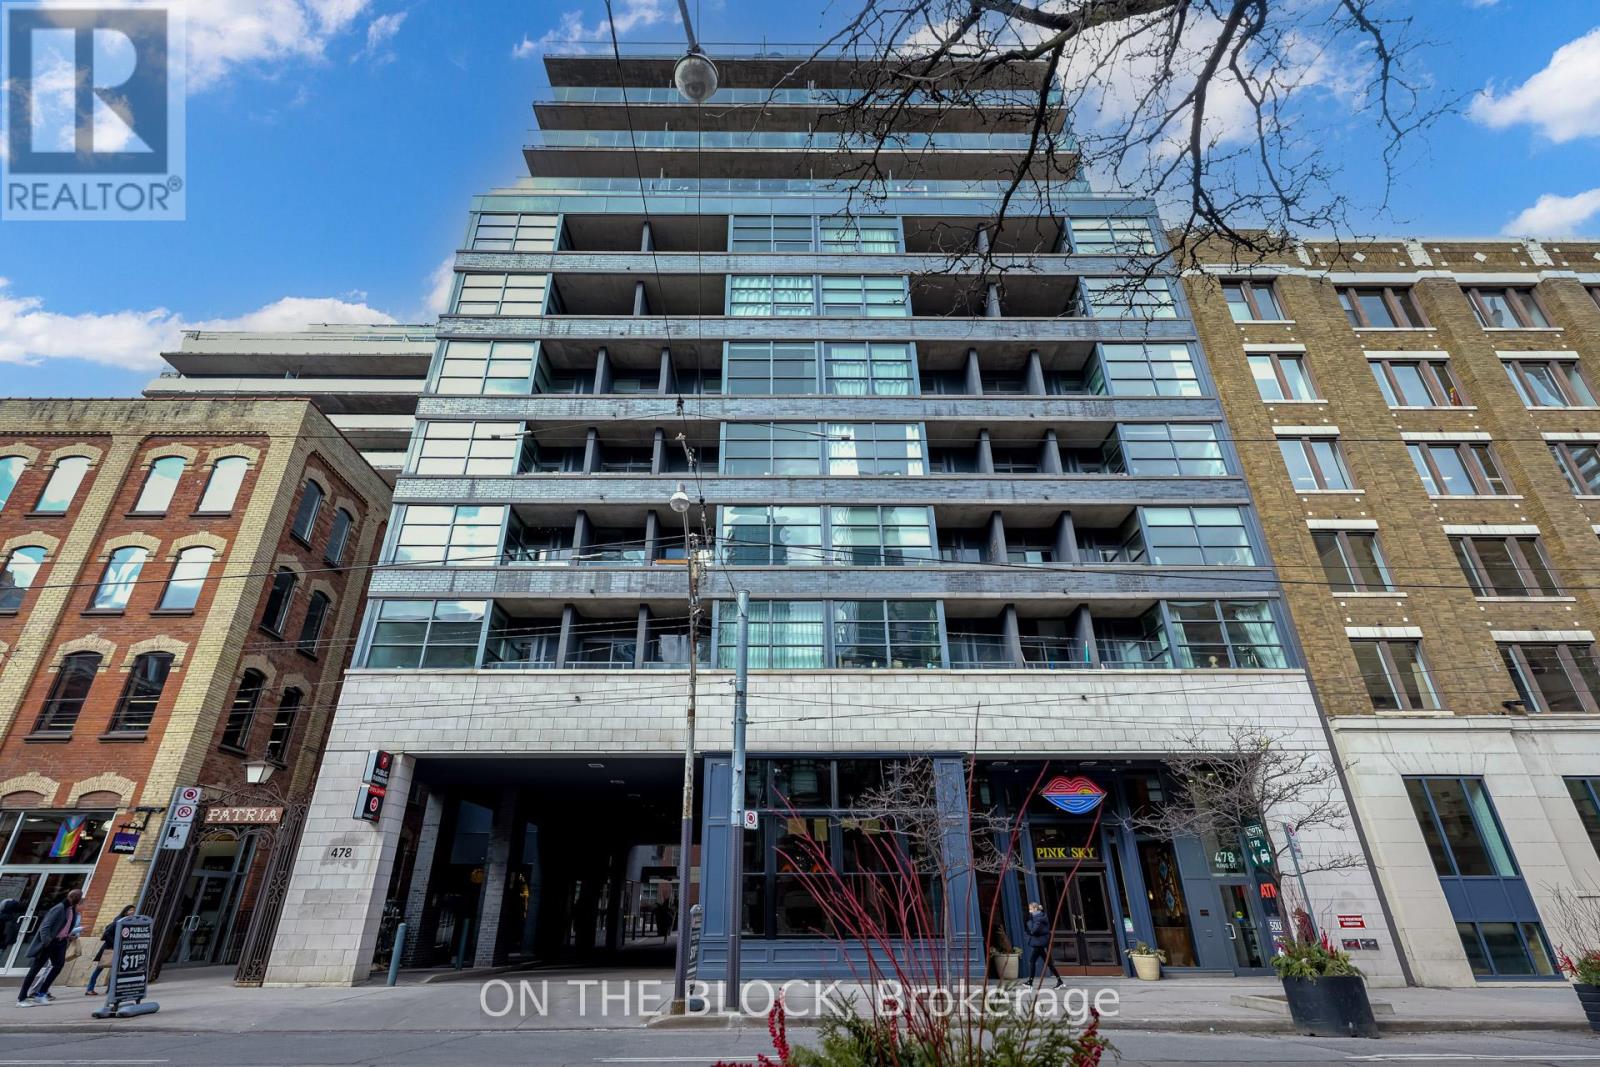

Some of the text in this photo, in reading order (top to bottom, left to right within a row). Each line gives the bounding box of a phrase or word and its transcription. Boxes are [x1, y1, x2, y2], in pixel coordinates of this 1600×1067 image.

[207, 808, 278, 822] PATRIA
[330, 847, 353, 858] 478
[1036, 847, 1096, 858] PINK SKY
[1214, 851, 1235, 863] 478
